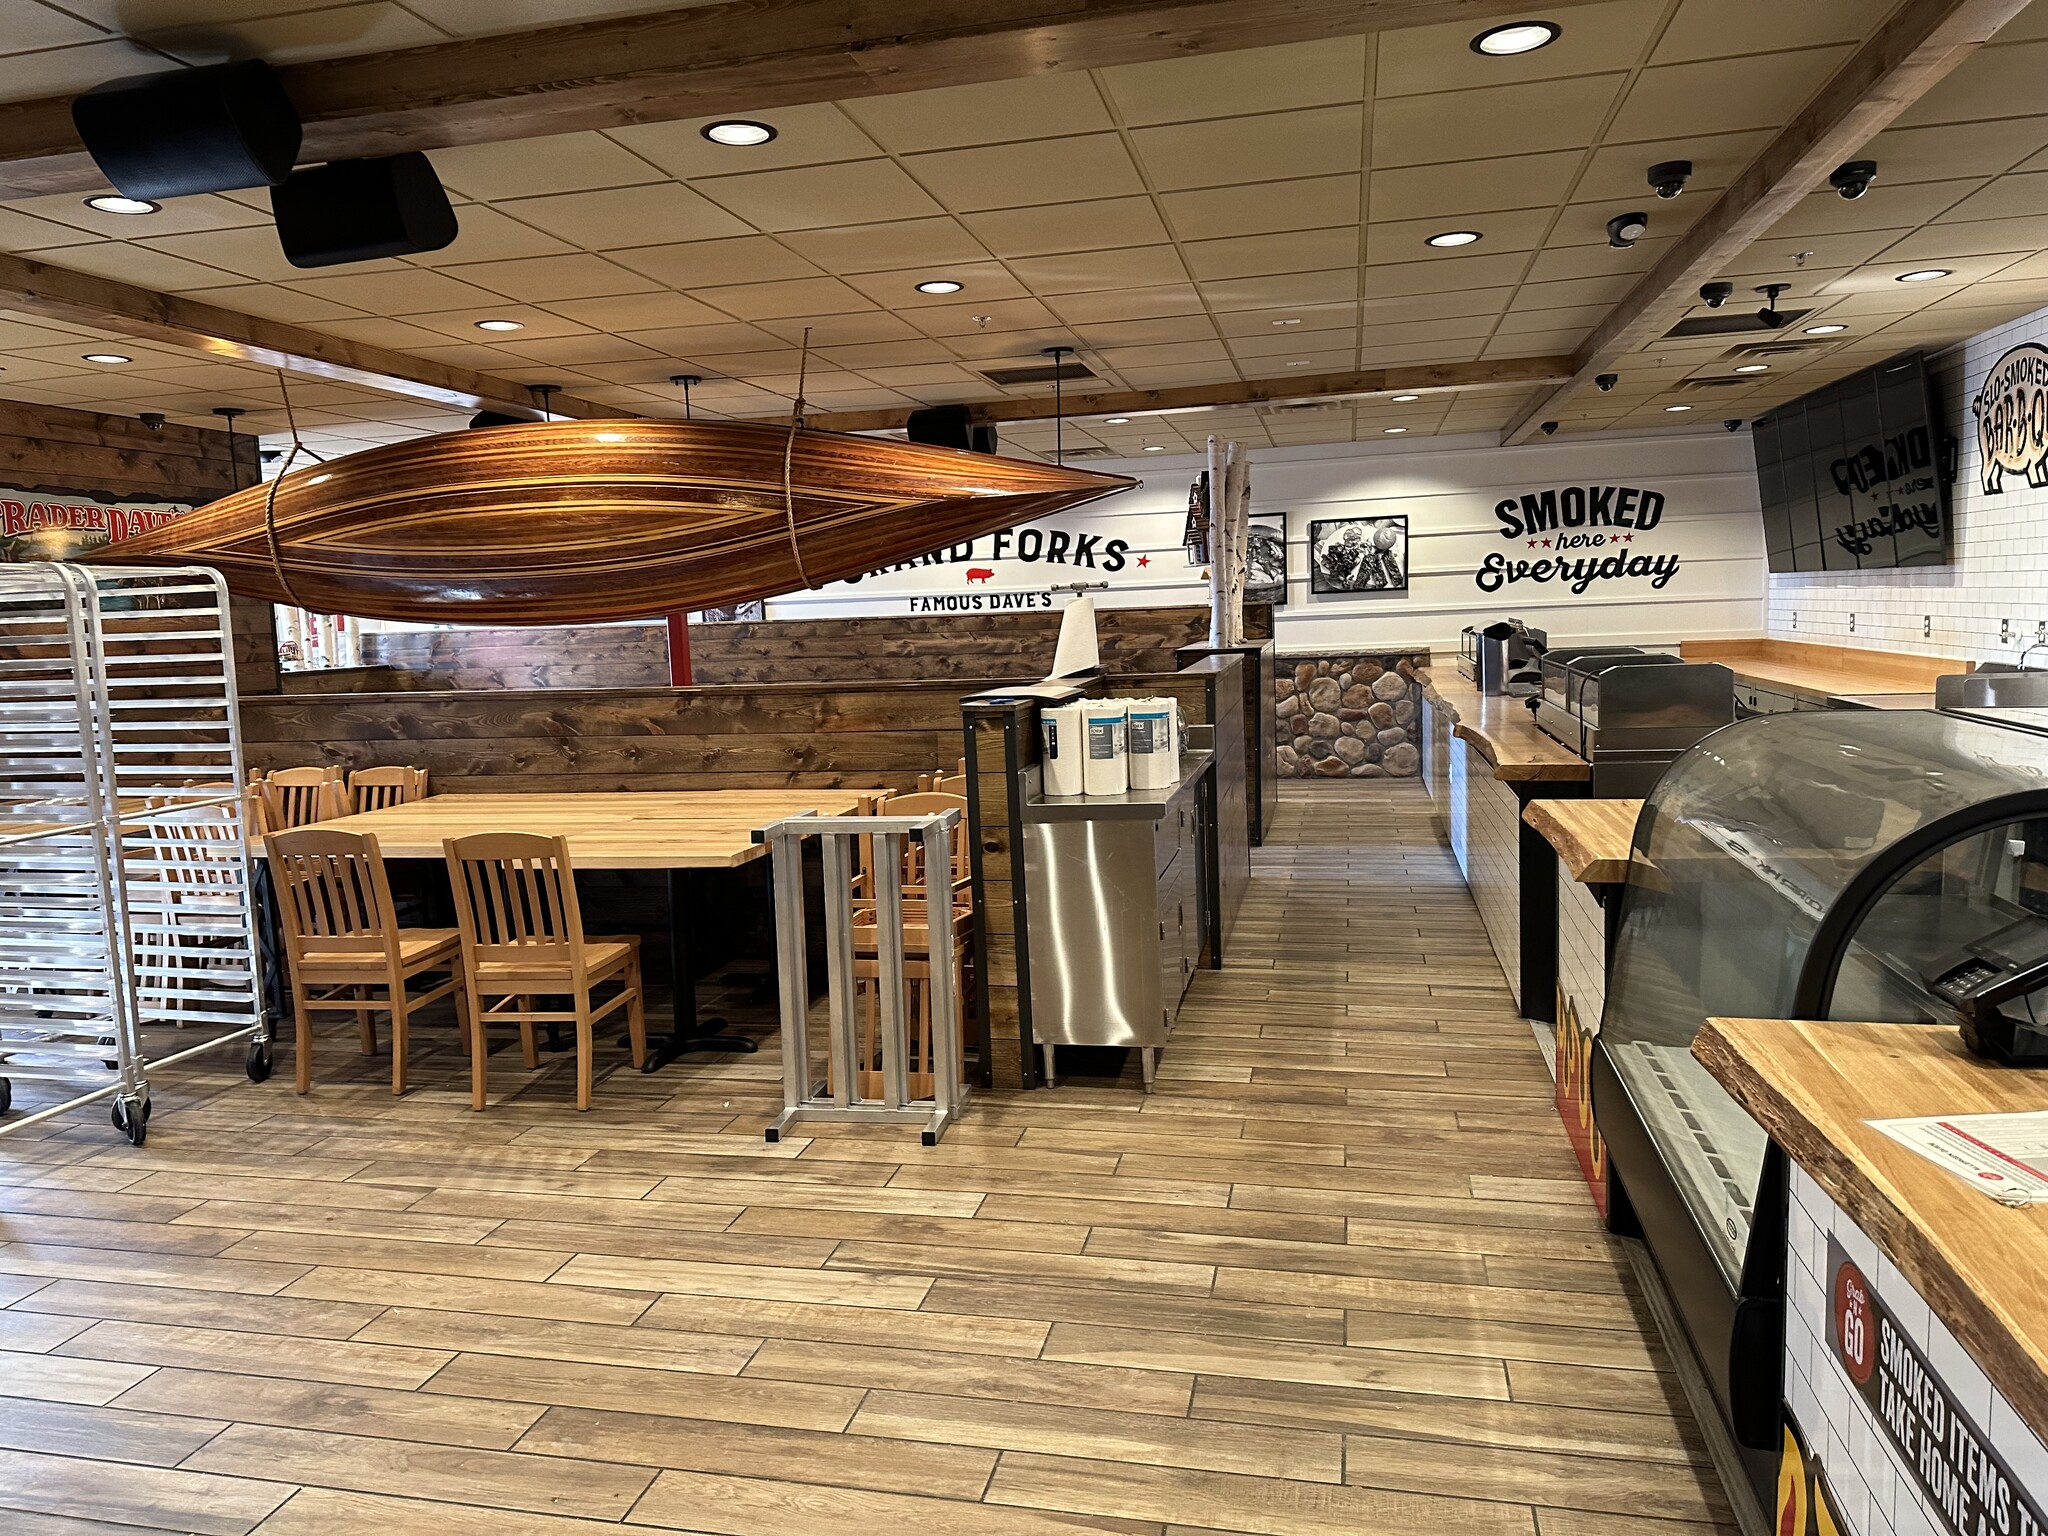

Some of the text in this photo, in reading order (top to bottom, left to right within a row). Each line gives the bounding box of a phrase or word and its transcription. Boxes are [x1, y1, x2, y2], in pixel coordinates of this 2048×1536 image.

[0, 500, 107, 538] RADER
[1494, 486, 1665, 539] SMOKED
[992, 529, 1129, 572] FORKS
[1555, 533, 1606, 550] here
[1476, 548, 1680, 594] Everyday
[910, 592, 1052, 612] FAMOUS DAVE'S
[1846, 1279, 1865, 1304] Grab
[1844, 1309, 1864, 1365] GO
[1879, 1318, 1945, 1442] SMOKED
[1950, 1411, 2010, 1536] ITEMS
[1879, 1366, 1971, 1536] TAKE HOME
